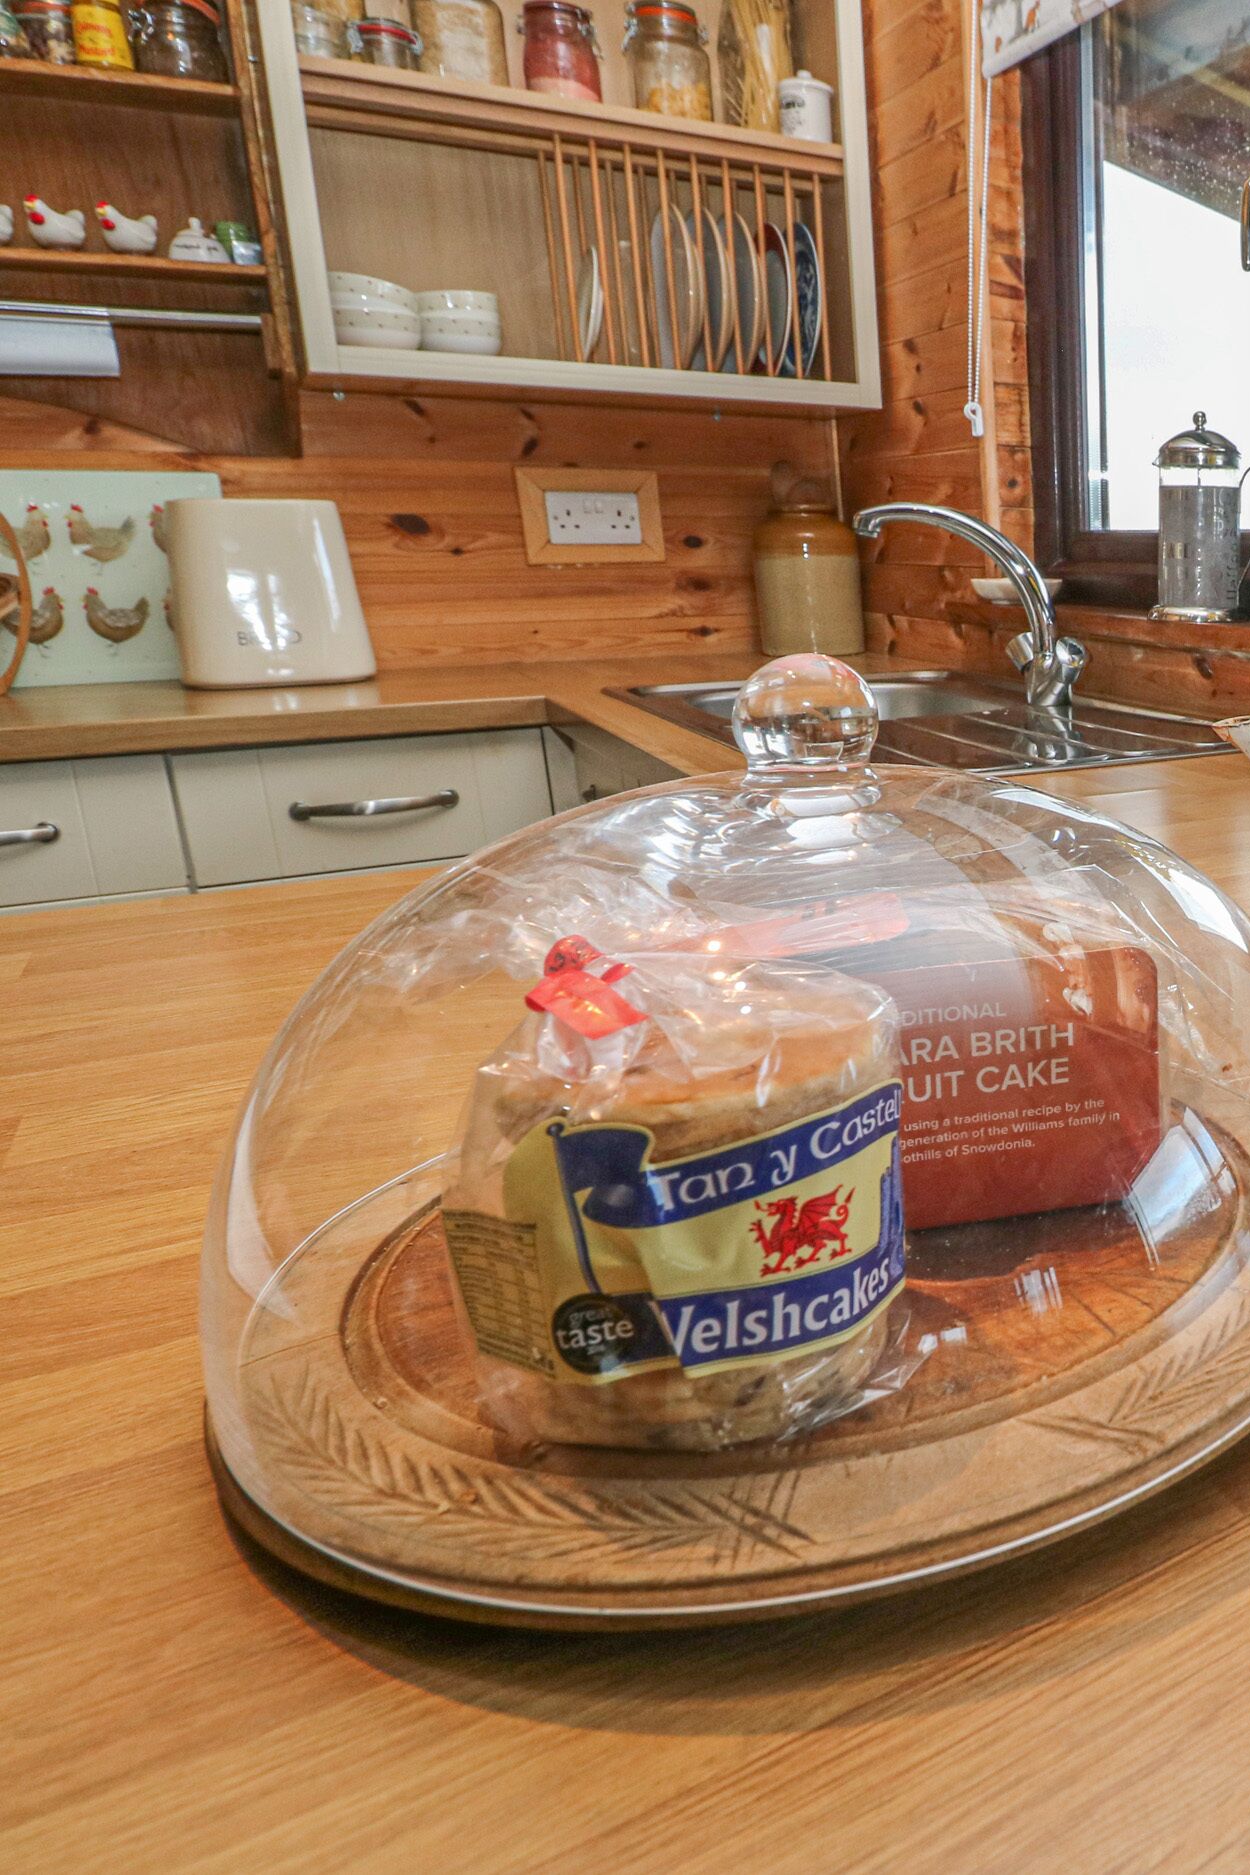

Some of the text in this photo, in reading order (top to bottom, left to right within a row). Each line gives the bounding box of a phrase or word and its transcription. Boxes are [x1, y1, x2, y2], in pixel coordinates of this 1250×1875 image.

[901, 1003, 1007, 1027] DITIONAL
[970, 1022, 1074, 1057] BRITH
[901, 1057, 1070, 1103] UIT CAKE
[900, 1110, 1121, 1150] generation of the Williams family in
[904, 1098, 1105, 1133] using a traditional recipe by the
[901, 1137, 1036, 1164] othills of Snowdonia.
[648, 1160, 756, 1211] Tan
[769, 1144, 797, 1186] y
[556, 1319, 635, 1350] taste
